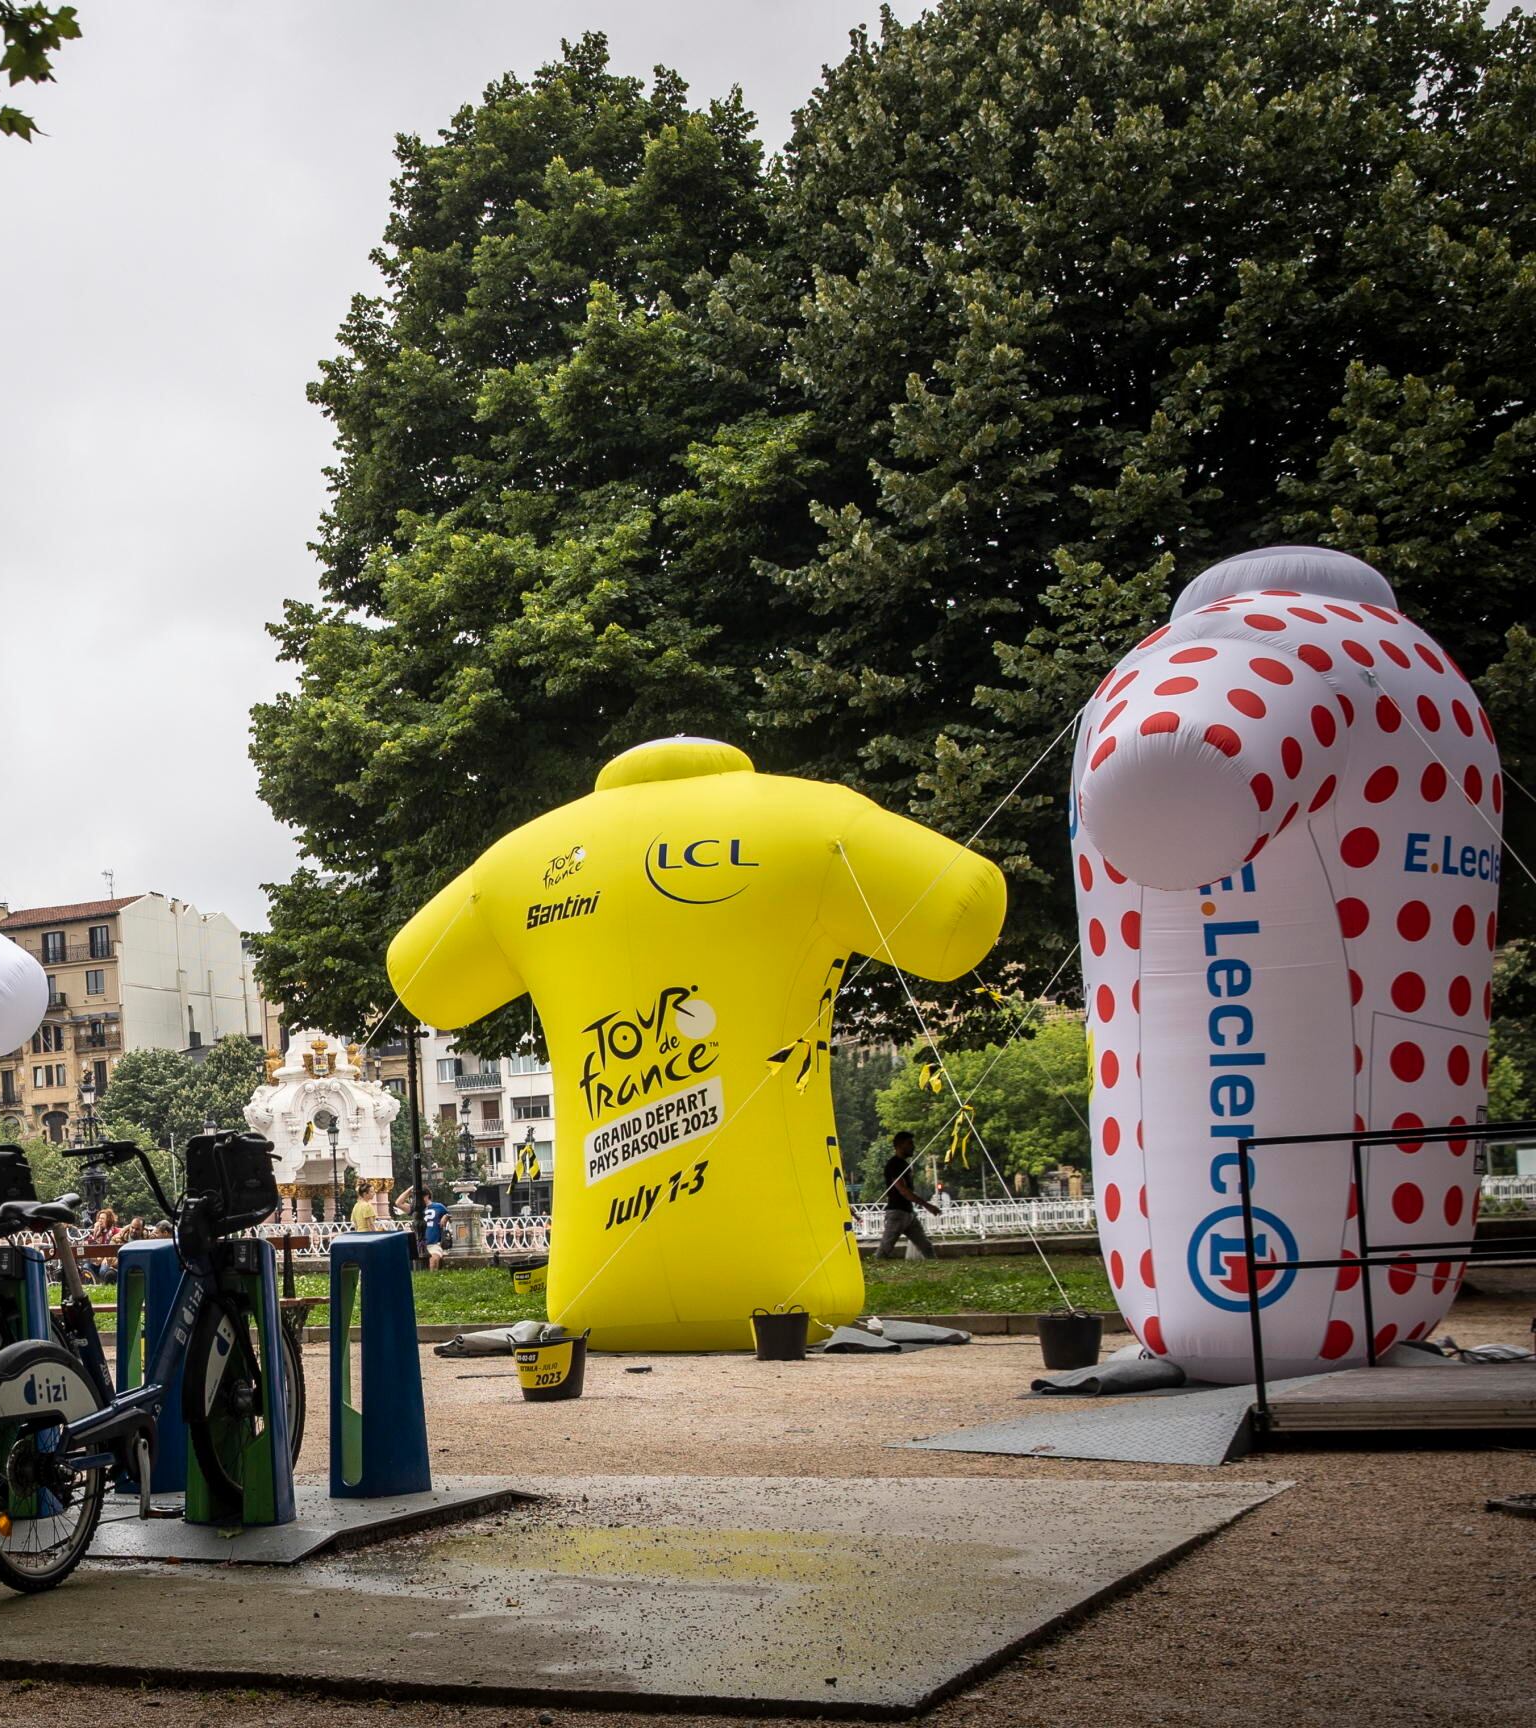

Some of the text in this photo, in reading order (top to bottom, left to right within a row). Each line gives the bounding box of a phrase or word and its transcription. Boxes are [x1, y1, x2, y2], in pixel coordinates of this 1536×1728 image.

[658, 839, 760, 869] LCL
[526, 891, 601, 930] Santini
[659, 1032, 680, 1054] de
[593, 1088, 708, 1154] GRAND DÉPART
[589, 1106, 718, 1178] PAYS BASQUE 2023
[605, 1160, 709, 1230] July 1-3
[535, 1371, 561, 1386] 2023
